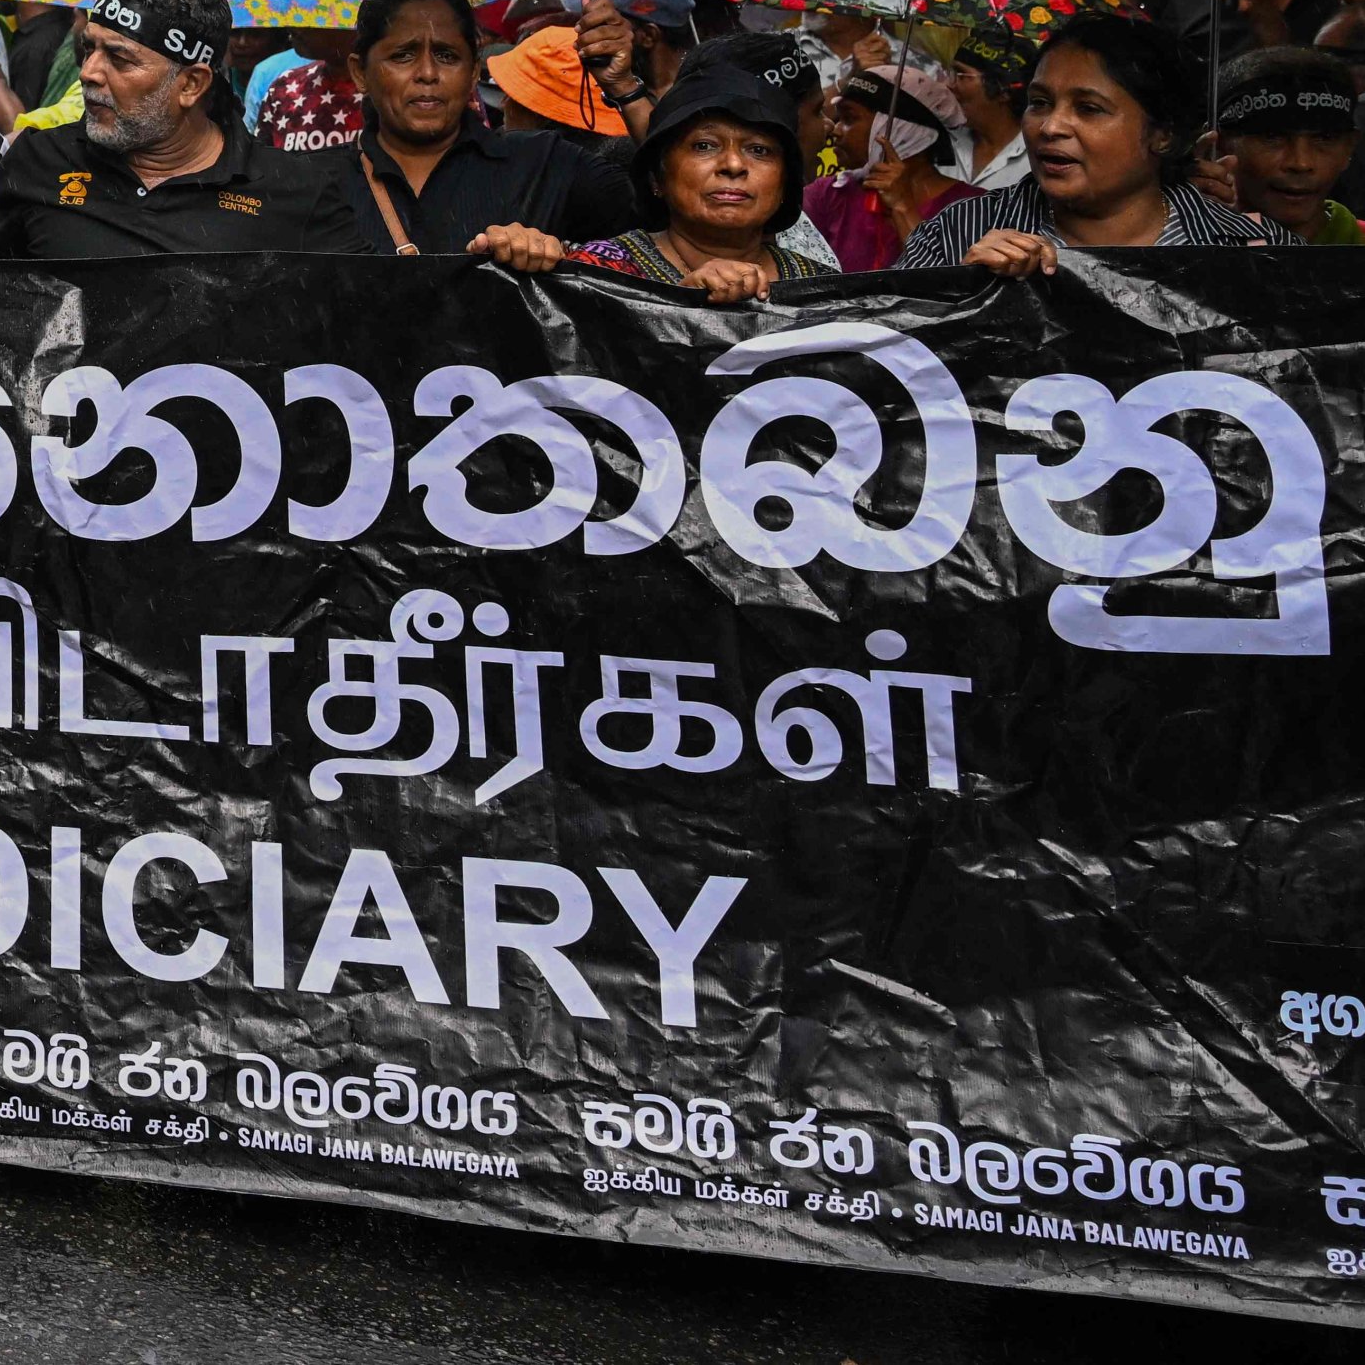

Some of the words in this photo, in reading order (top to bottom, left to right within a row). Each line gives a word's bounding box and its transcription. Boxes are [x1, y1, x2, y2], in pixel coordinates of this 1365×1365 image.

[283, 129, 364, 152] BROOK
[59, 196, 85, 206] SJB
[218, 190, 262, 208] COLOMBO
[218, 200, 260, 216] CENTRAL
[118, 1041, 208, 1102] ජන
[51, 1107, 132, 1134] மக்கள்
[145, 1116, 211, 1146] சக்தி
[237, 1126, 313, 1155] SAMAGI
[318, 1136, 375, 1163] JANA
[380, 1143, 519, 1179] BALAWEGAYA
[579, 1093, 736, 1161] සමගි
[768, 1107, 875, 1177] ජන
[694, 1178, 788, 1209] மக்கள்
[803, 1187, 880, 1222] சக்தி
[914, 1203, 1004, 1236] SAMAGI
[1010, 1213, 1076, 1243] JANA
[1084, 1221, 1250, 1261] BALAWEGAYA
